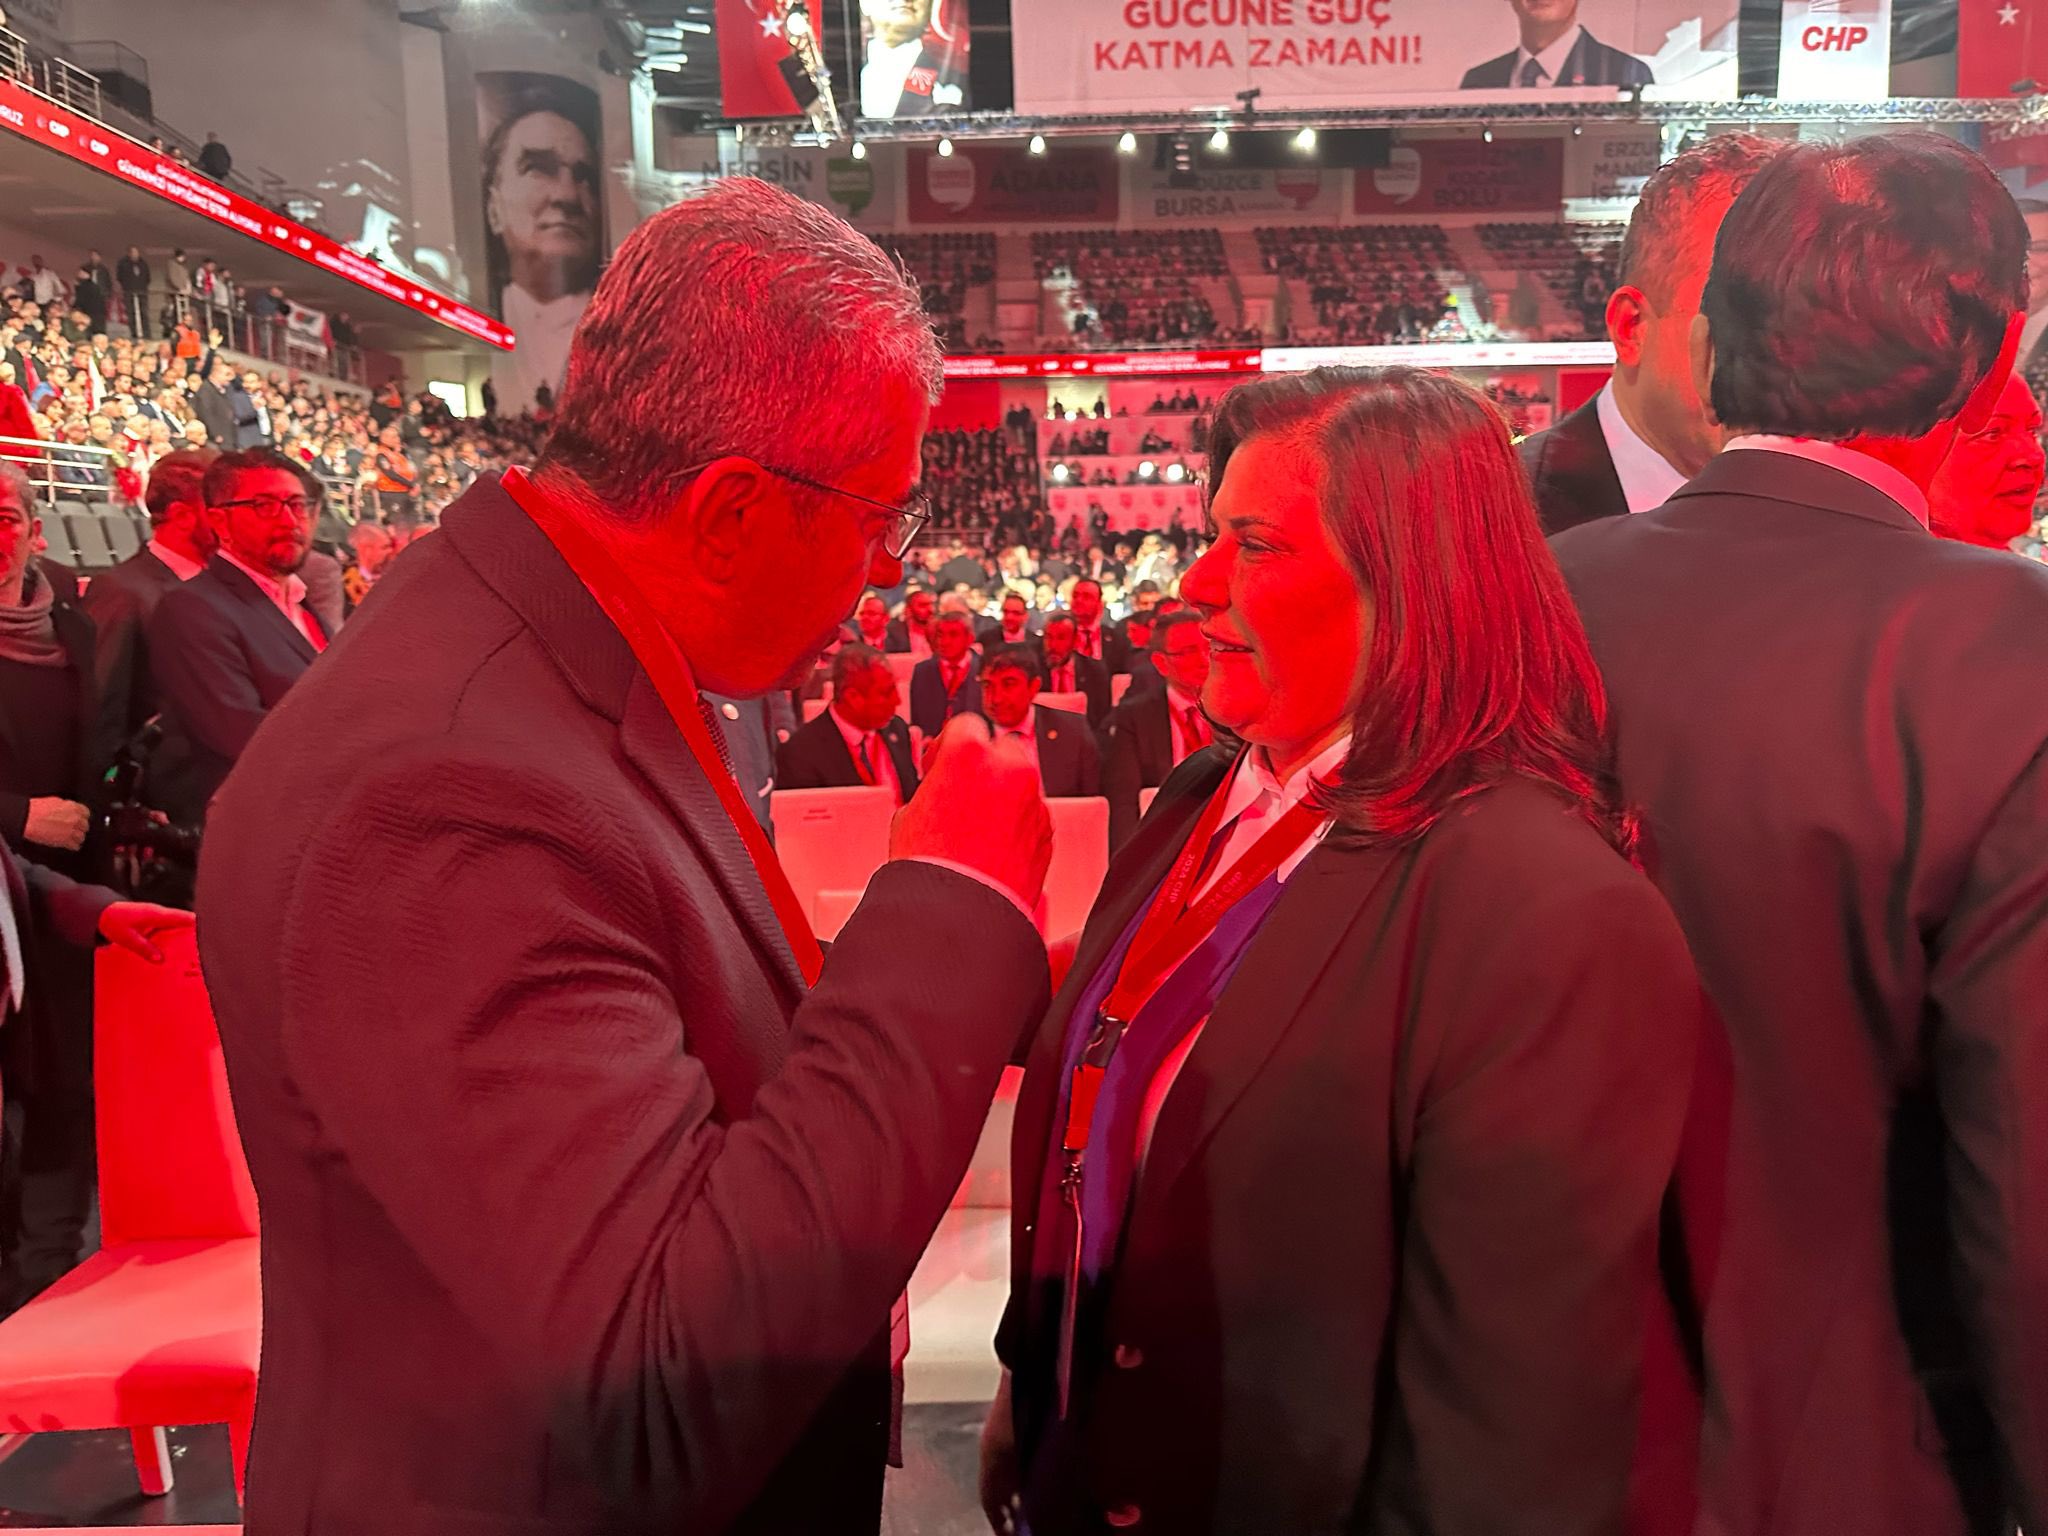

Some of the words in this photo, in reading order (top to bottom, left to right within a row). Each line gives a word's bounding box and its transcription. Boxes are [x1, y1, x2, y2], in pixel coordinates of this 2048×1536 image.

[1801, 26, 1868, 51] CHP
[1094, 40, 1233, 70] KATMA
[1249, 36, 1422, 67] ZAMANI!
[1155, 196, 1235, 217] BURSA
[1434, 187, 1500, 207] BOLU
